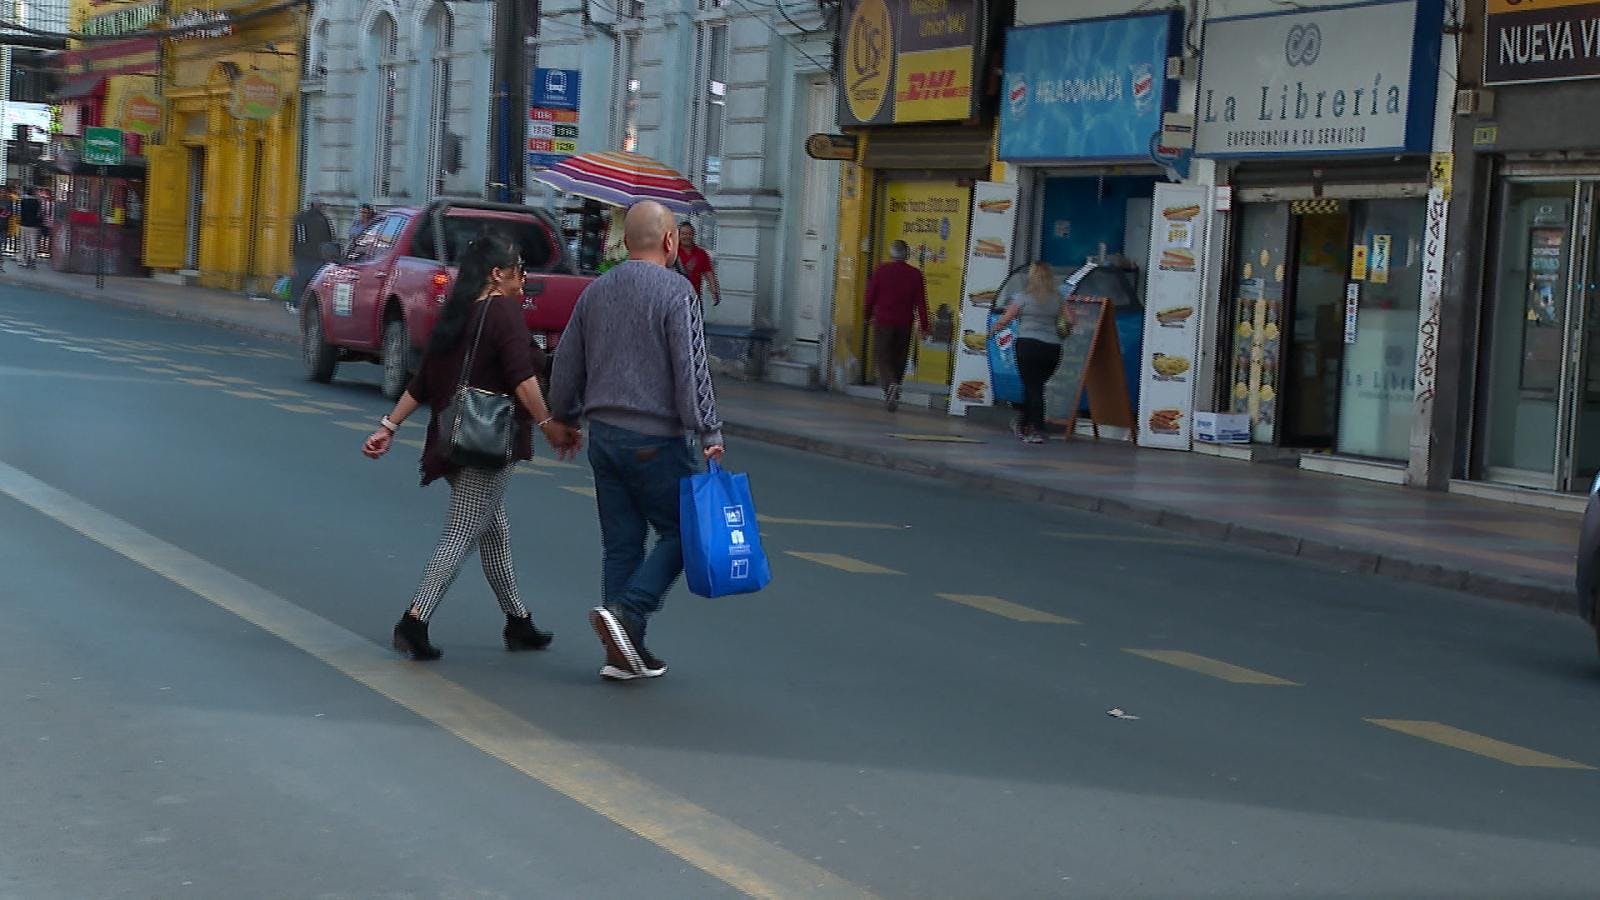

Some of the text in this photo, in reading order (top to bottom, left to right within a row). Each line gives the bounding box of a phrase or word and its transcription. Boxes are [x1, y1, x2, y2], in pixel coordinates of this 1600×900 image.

[1498, 21, 1575, 65] NUEVA
[906, 69, 957, 100] DHL
[1203, 73, 1400, 123] La Librería
[1226, 126, 1367, 148] EXPERIENCIA A SU SERVICIO
